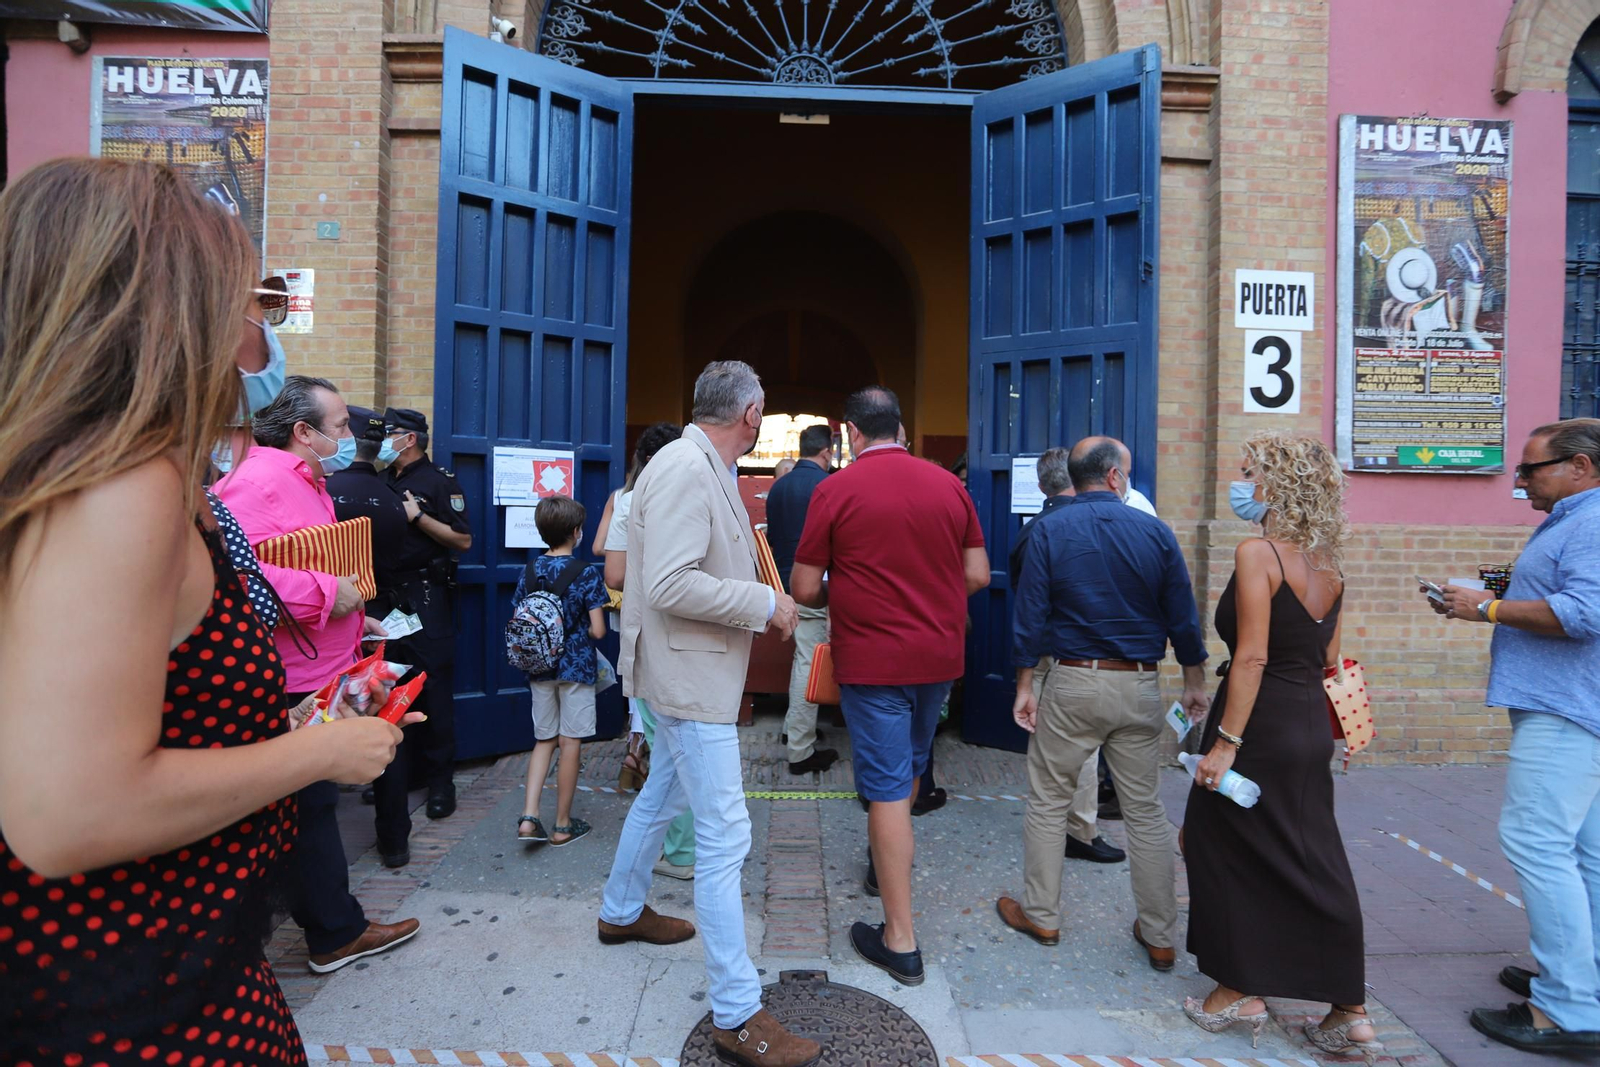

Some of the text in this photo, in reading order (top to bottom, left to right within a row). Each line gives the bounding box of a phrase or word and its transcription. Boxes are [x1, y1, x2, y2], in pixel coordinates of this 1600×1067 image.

[107, 66, 264, 96] HUELVA
[194, 96, 263, 105] Fiestas Colombinas
[211, 106, 248, 117] 2020
[1360, 123, 1506, 154] HUELVA
[1440, 153, 1504, 164] Fiestas Colombinas
[1455, 164, 1489, 175] 2020
[324, 223, 331, 237] 2
[1241, 282, 1307, 317] PUERTA
[1250, 335, 1295, 409] 3
[1357, 383, 1386, 391] PABLO
[1387, 383, 1424, 392] AGUADO
[1438, 449, 1457, 457] CAJA
